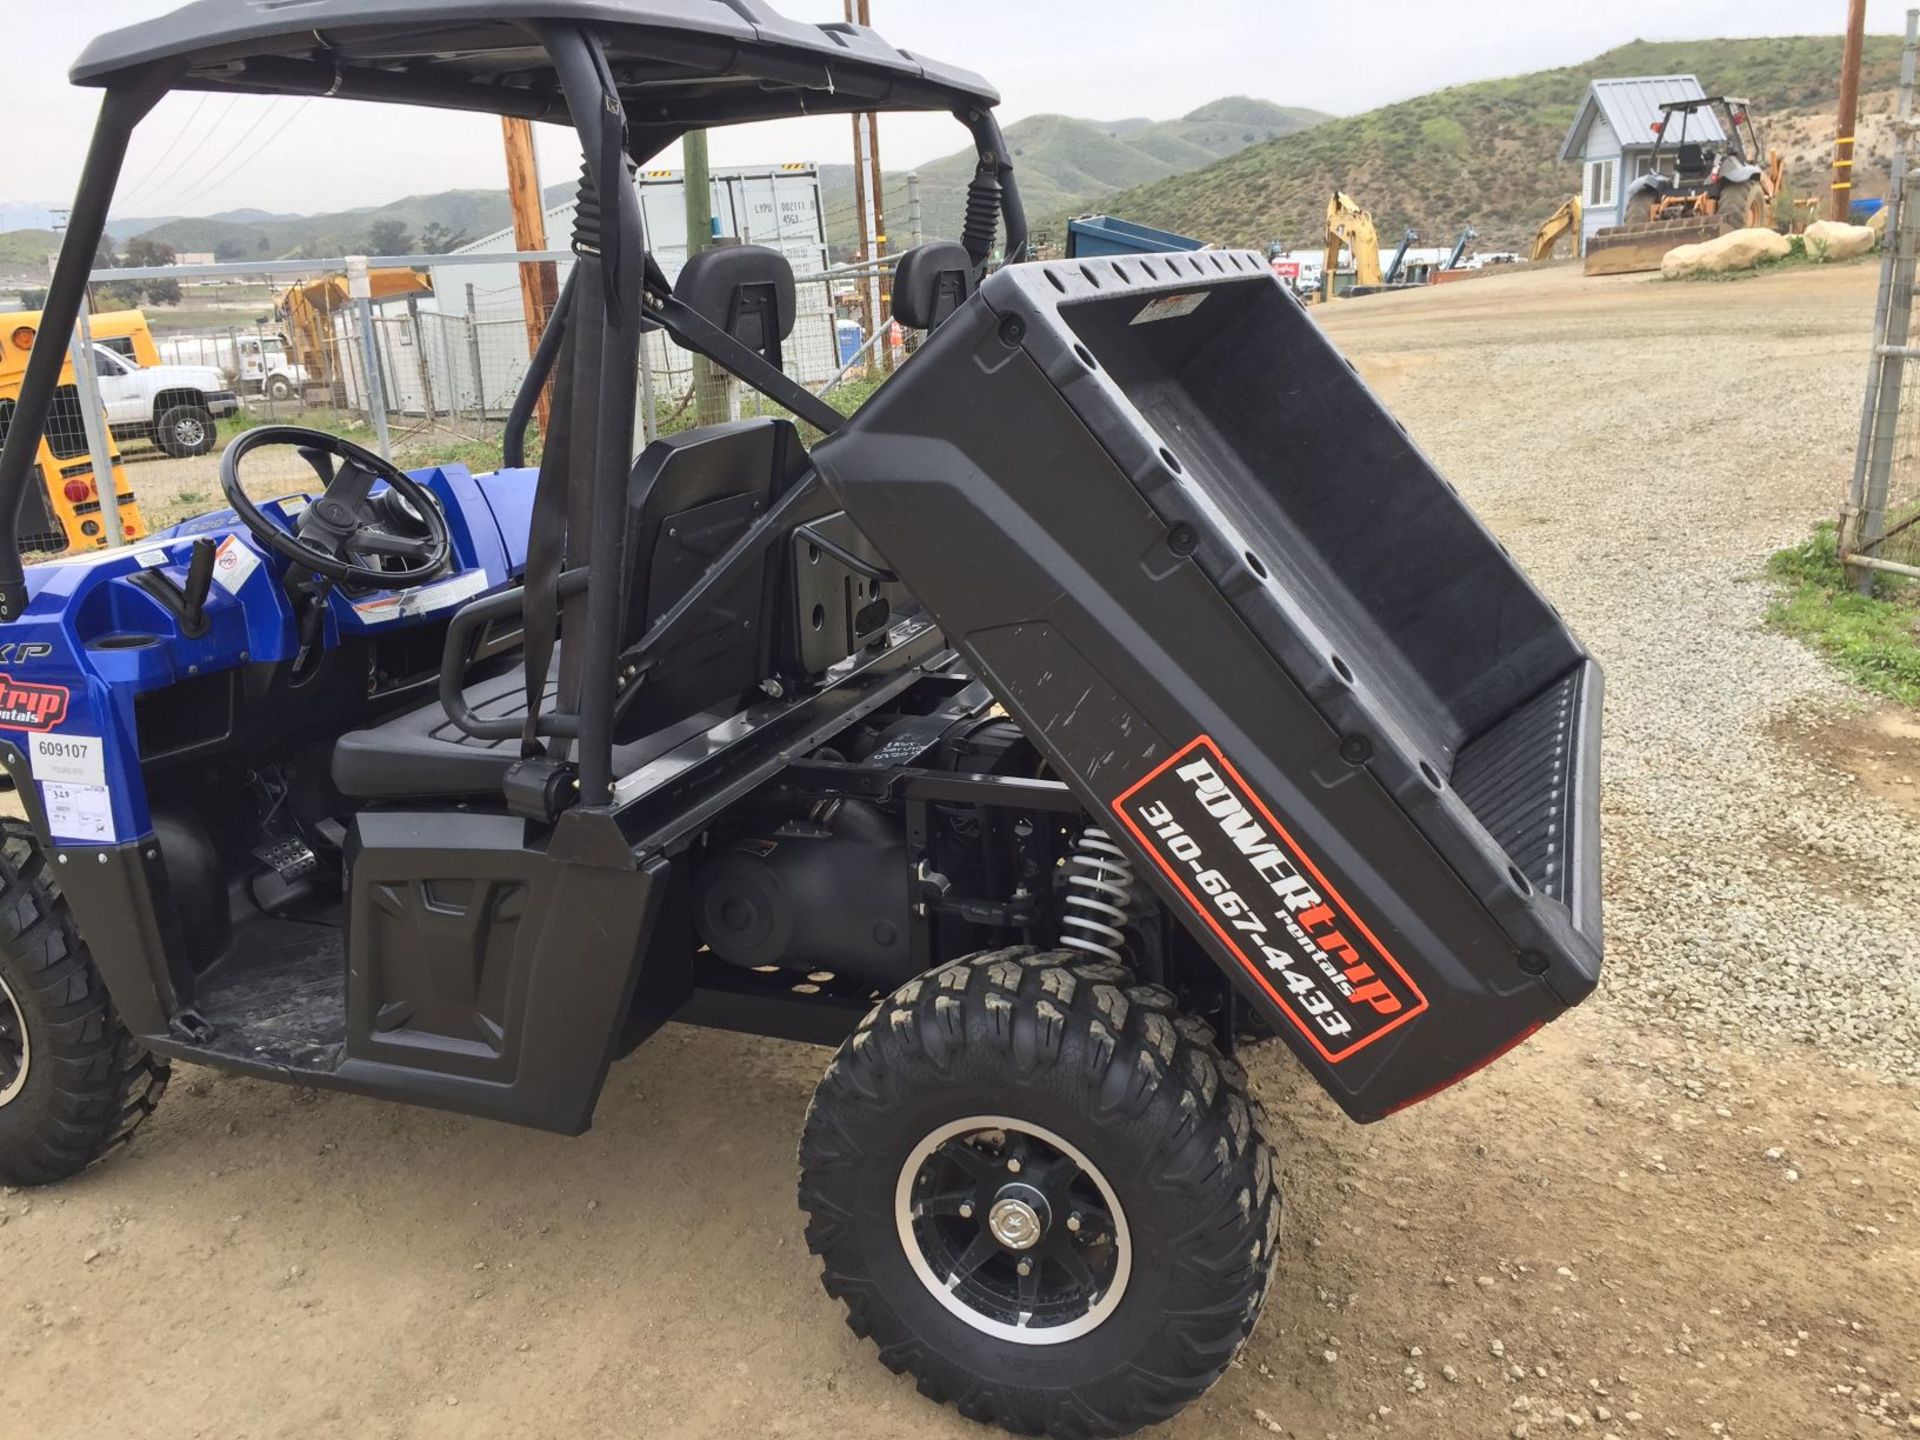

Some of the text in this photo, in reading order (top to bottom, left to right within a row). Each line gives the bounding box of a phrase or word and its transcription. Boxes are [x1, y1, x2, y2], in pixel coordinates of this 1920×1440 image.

[0, 709, 39, 723] ntals
[39, 741, 88, 759] 609107
[1138, 800, 1353, 1038] 310-667-4433
[1273, 908, 1358, 998] rentals
